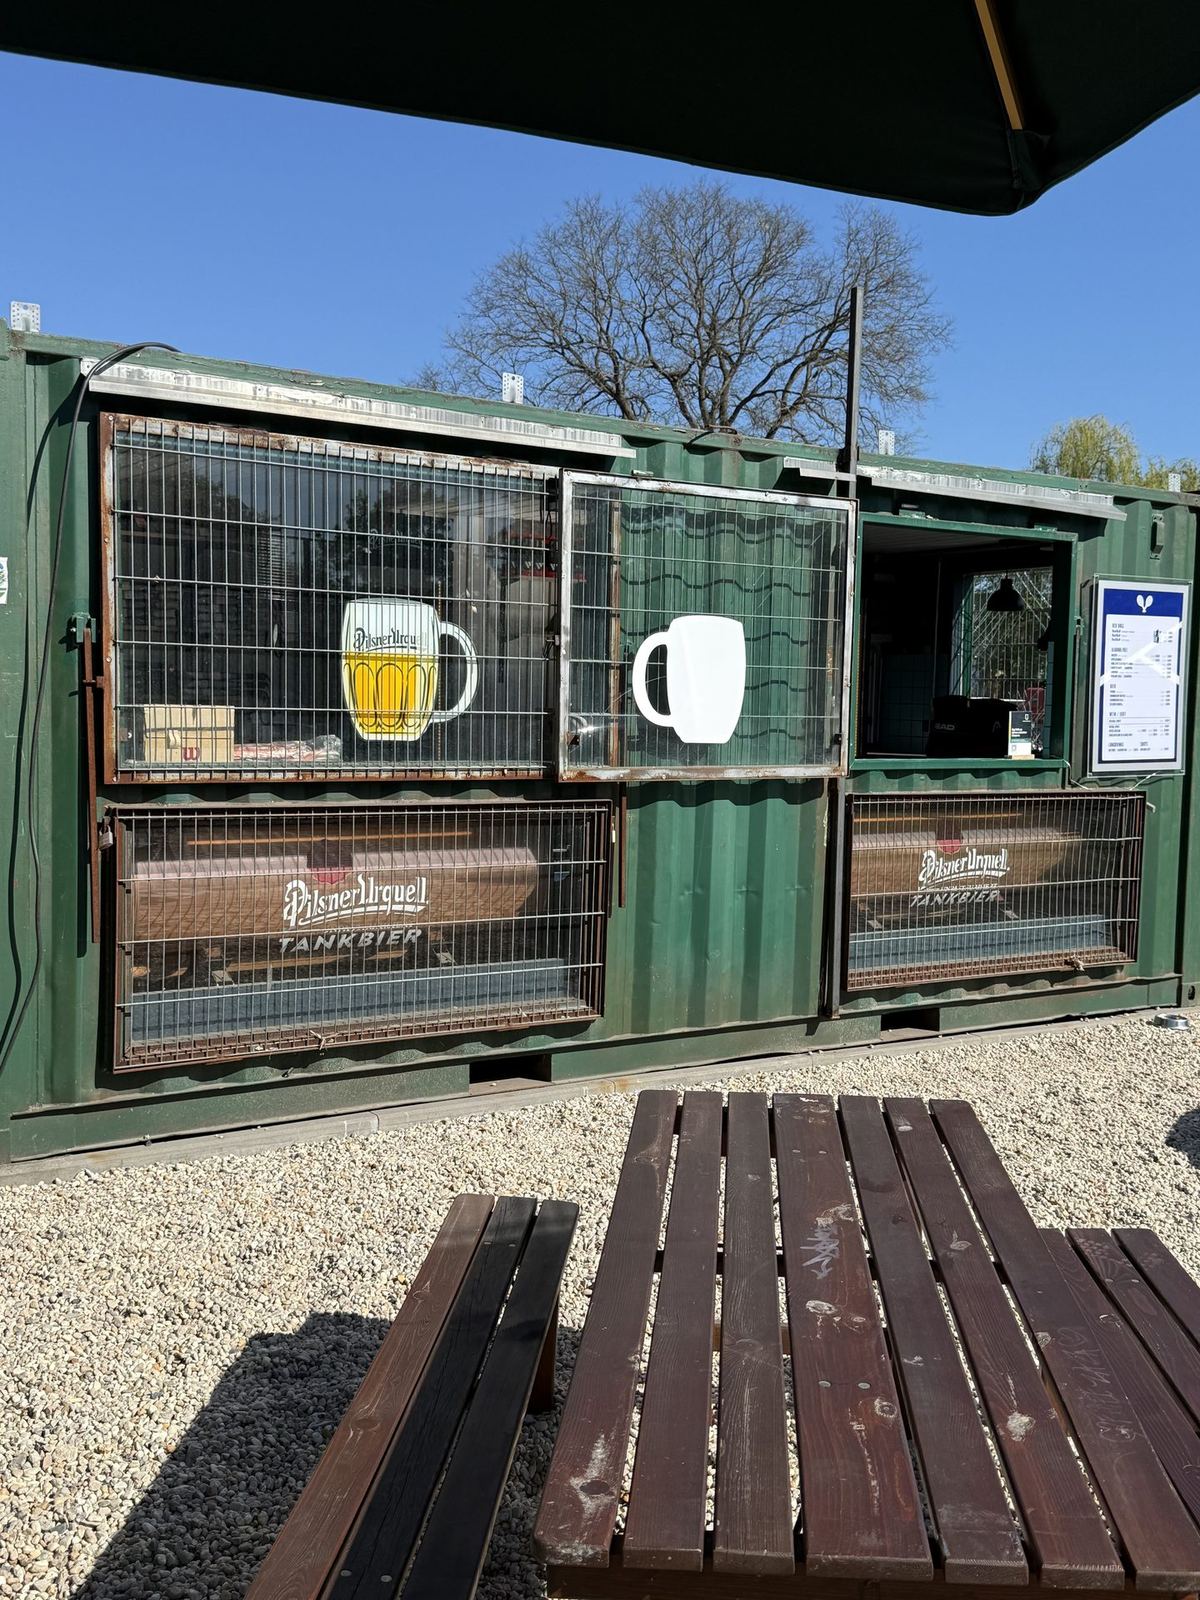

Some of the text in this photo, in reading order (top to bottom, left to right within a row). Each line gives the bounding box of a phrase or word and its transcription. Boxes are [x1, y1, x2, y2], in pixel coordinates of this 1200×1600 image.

[918, 849, 968, 889] Pilsner
[283, 873, 427, 927] Pilsner Urquell
[910, 889, 1001, 908] TANKBIER
[278, 928, 422, 953] TANKBIER
